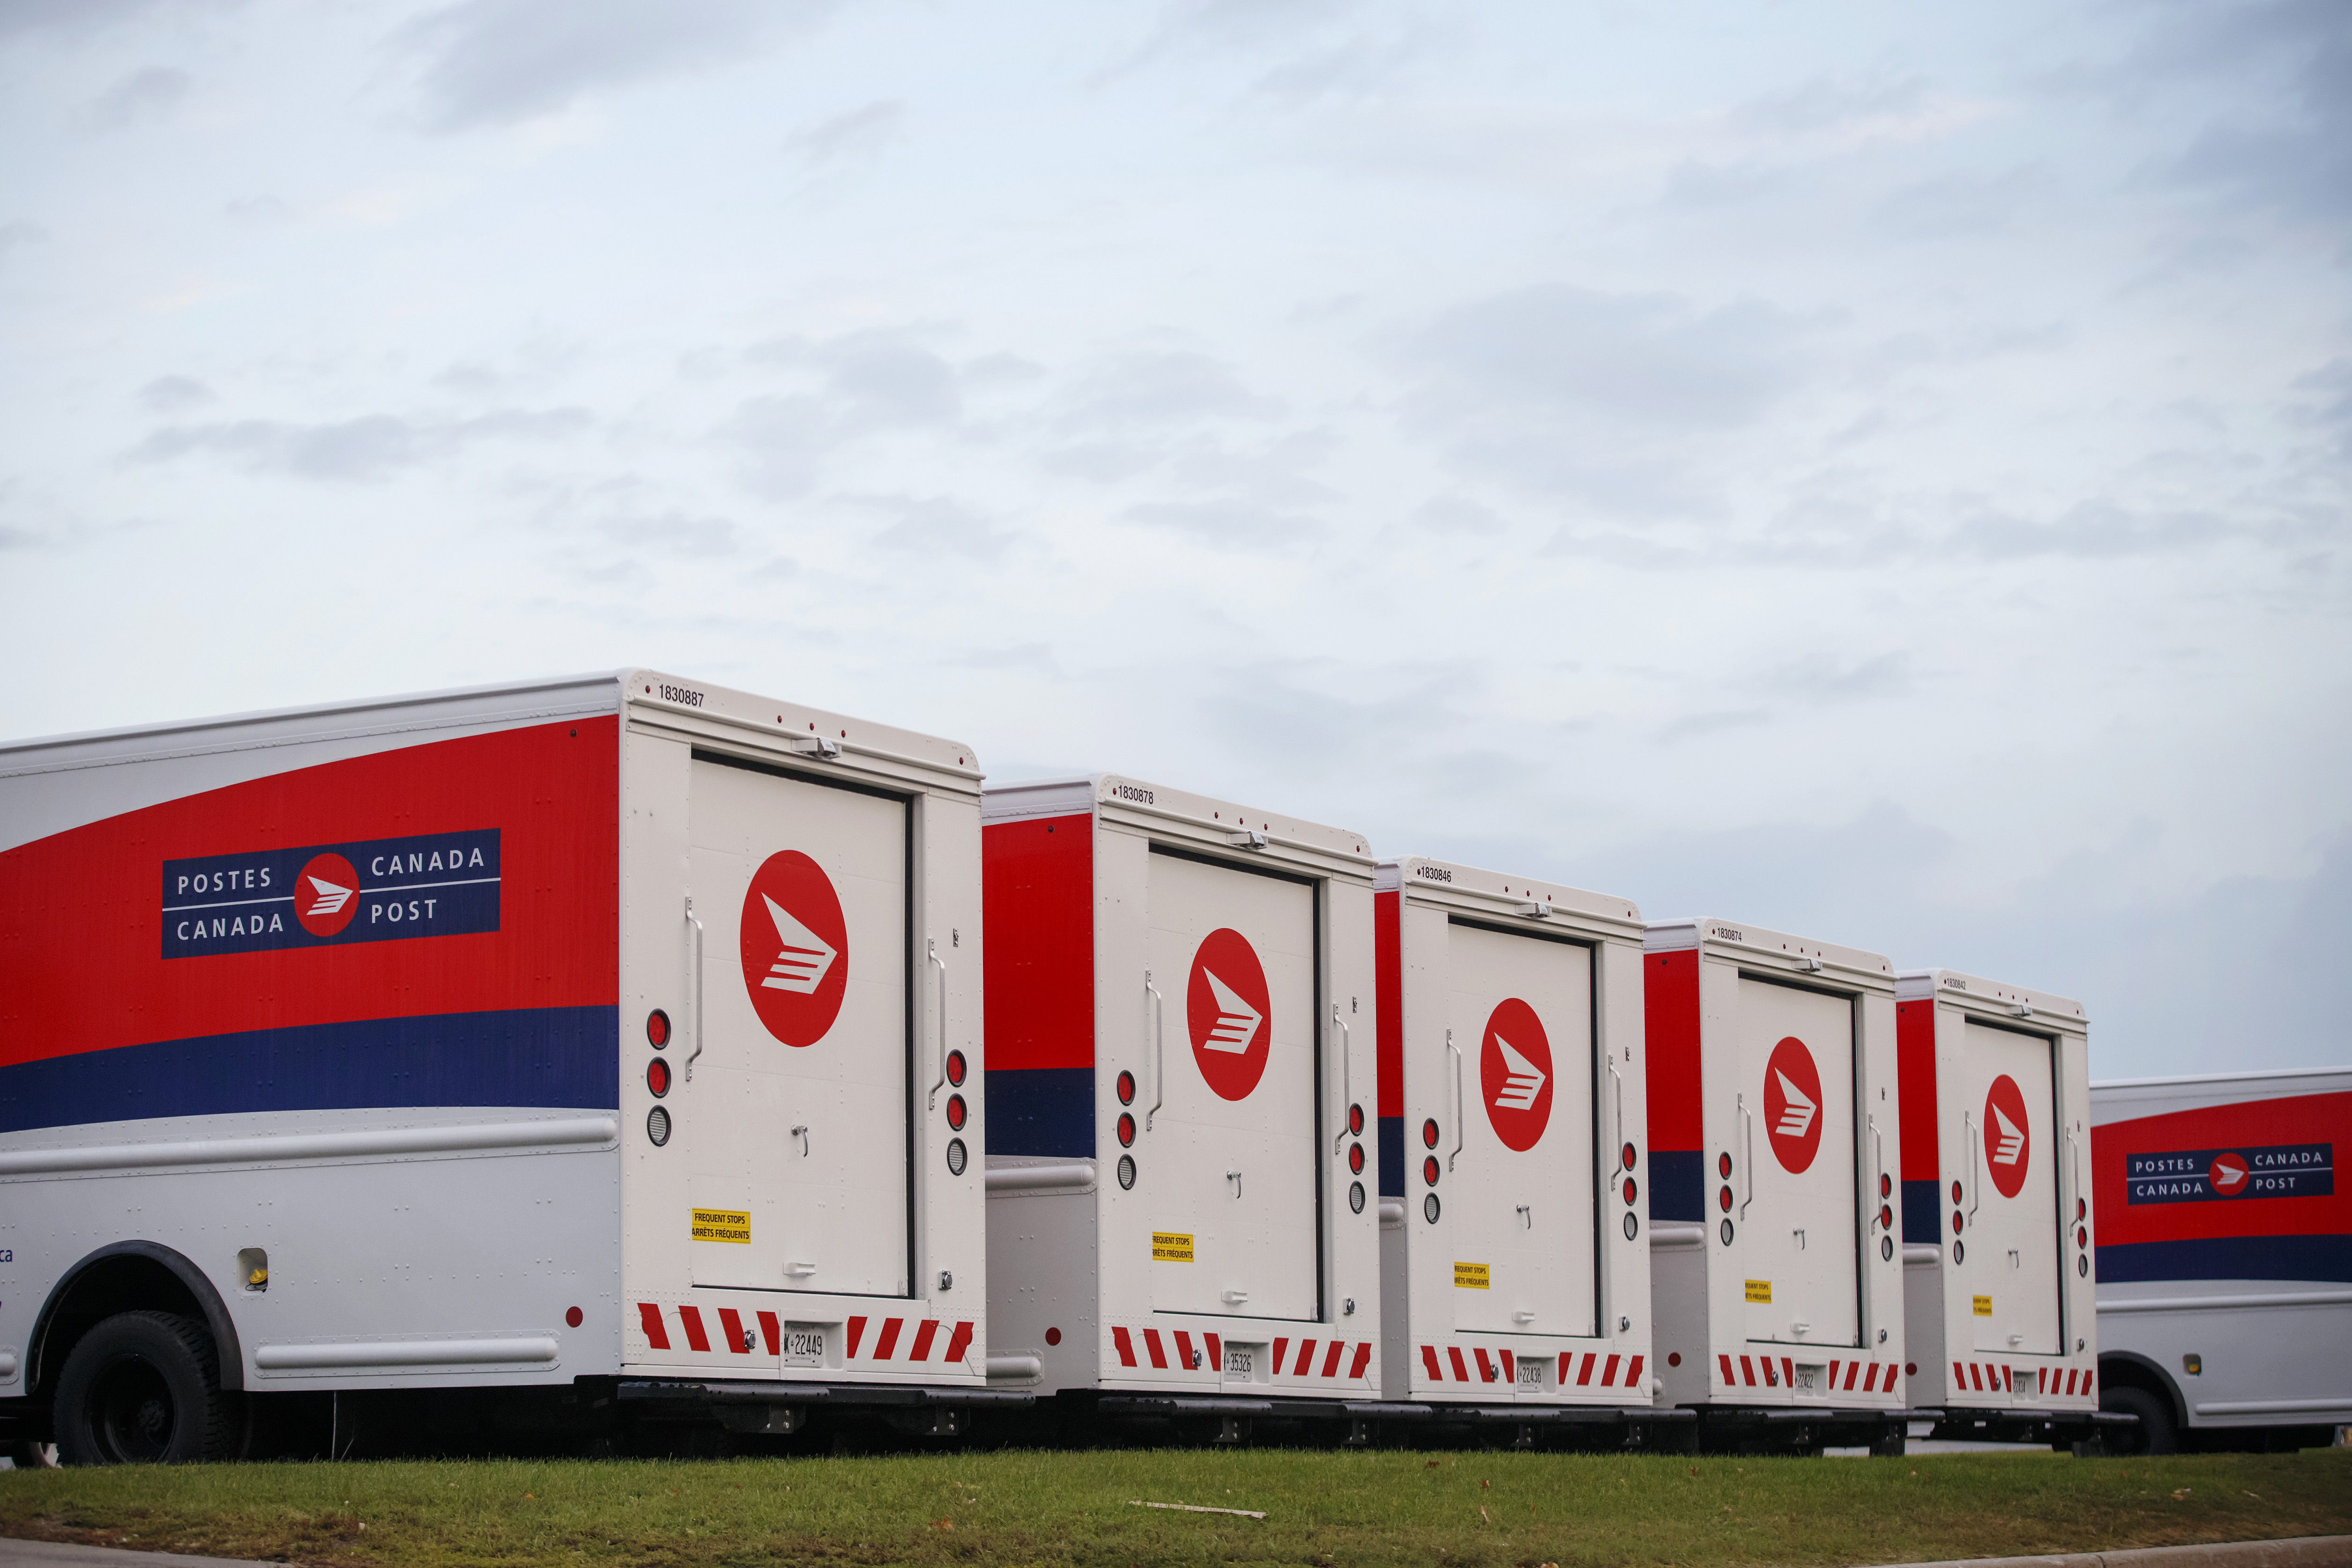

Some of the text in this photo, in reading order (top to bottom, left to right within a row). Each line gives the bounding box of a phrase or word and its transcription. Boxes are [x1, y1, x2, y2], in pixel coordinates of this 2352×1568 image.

[659, 684, 704, 707] 1830887
[1119, 785, 1154, 804] 1830878
[178, 847, 484, 894] POSTES CANADA
[1422, 866, 1451, 883] 1830846
[177, 899, 437, 940] CANADA POST
[1718, 927, 1742, 942] 1830874
[1947, 978, 1966, 990] 1830842
[2136, 1151, 2323, 1173] POSTES CANADA
[2136, 1177, 2296, 1197] CANADA POST
[695, 1213, 745, 1224] FREQUENT STOPS
[692, 1226, 749, 1240] ARRÊTS FRÉQUENTS
[1167, 1248, 1193, 1259] FRÉQUENTS
[795, 1334, 822, 1355] 22449
[1230, 1352, 1251, 1372] 35326
[1522, 1367, 1541, 1383] 22438
